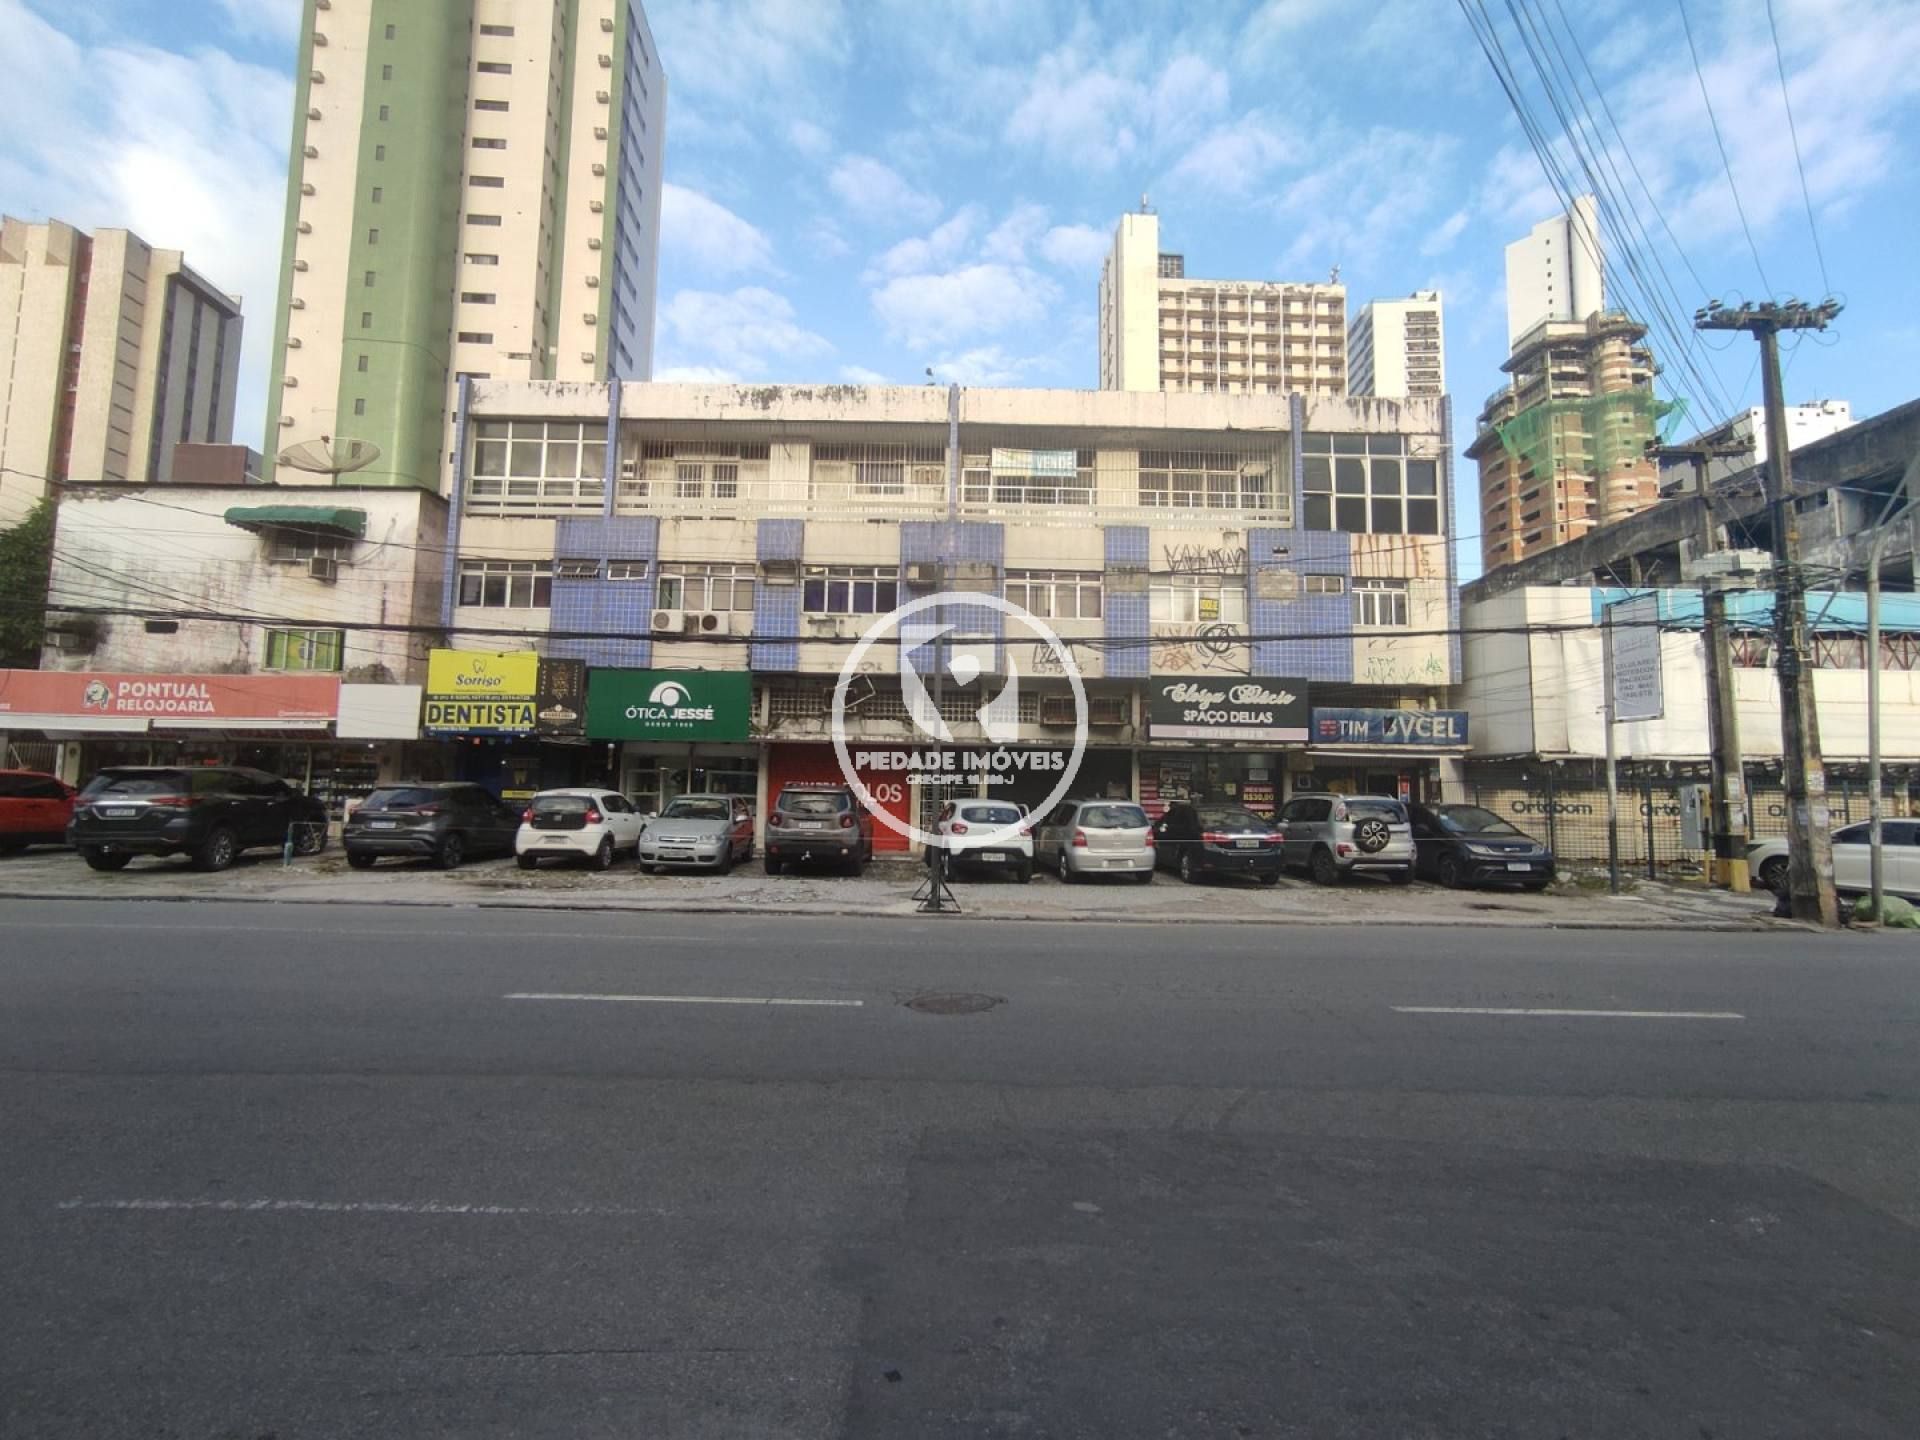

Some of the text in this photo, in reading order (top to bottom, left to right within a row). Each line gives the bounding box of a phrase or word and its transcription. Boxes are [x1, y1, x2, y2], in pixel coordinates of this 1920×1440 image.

[117, 681, 210, 698] PONTUAL
[116, 699, 215, 714] RELOJOARIA
[427, 704, 534, 725] DENTISTA
[625, 704, 714, 720] ÓTICA JESSÉ
[1183, 710, 1273, 724] SPAÇO DELLAS
[1339, 719, 1369, 737] TIM
